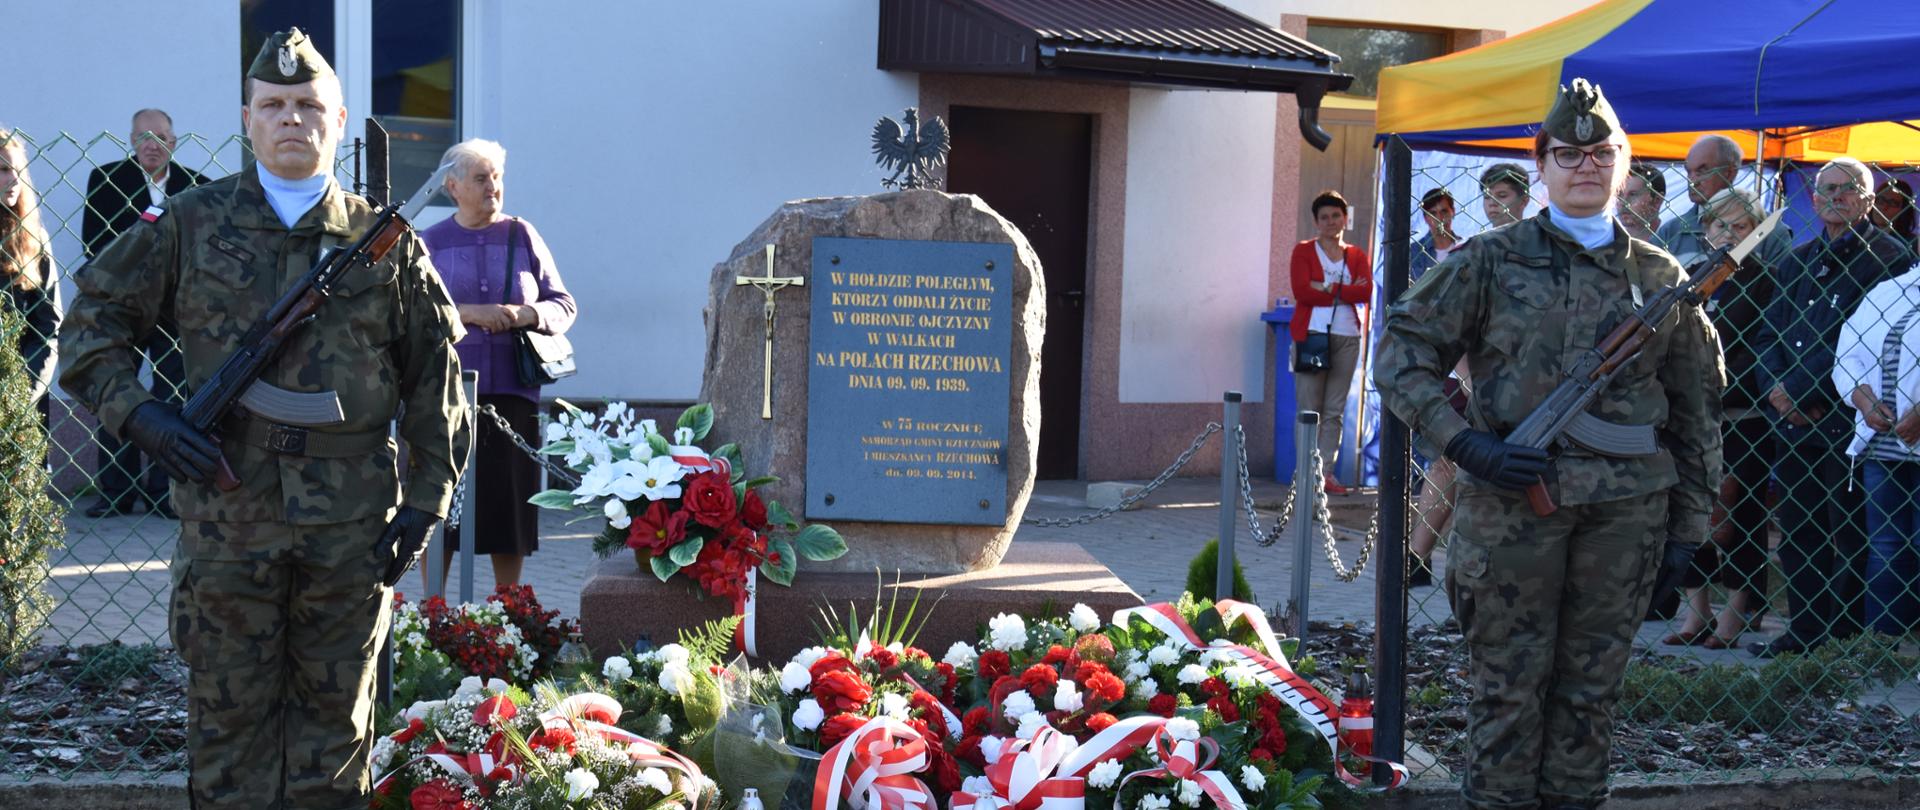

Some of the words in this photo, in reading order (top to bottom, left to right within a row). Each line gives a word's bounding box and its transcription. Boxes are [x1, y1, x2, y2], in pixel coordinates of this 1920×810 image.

[831, 272, 846, 286] W
[849, 273, 911, 288] HOŁDZIE
[915, 276, 995, 293] POLEGŁYM,
[892, 294, 945, 310] ODDALI
[949, 294, 991, 312] ŻYCIE
[832, 311, 847, 325] W
[850, 312, 915, 328] OBRONIE
[918, 314, 992, 330] OJCZYZNY
[867, 331, 882, 345] W
[886, 332, 956, 348] WALKACH
[816, 352, 835, 367] NA
[908, 353, 1002, 373] RZECHOWA
[848, 374, 883, 389] DNIA
[886, 376, 906, 390] 09.
[911, 377, 931, 391] 09.
[935, 377, 970, 392] 1939.
[882, 420, 894, 431] W
[898, 417, 913, 432] 75
[936, 452, 1000, 466] RZECHOWA
